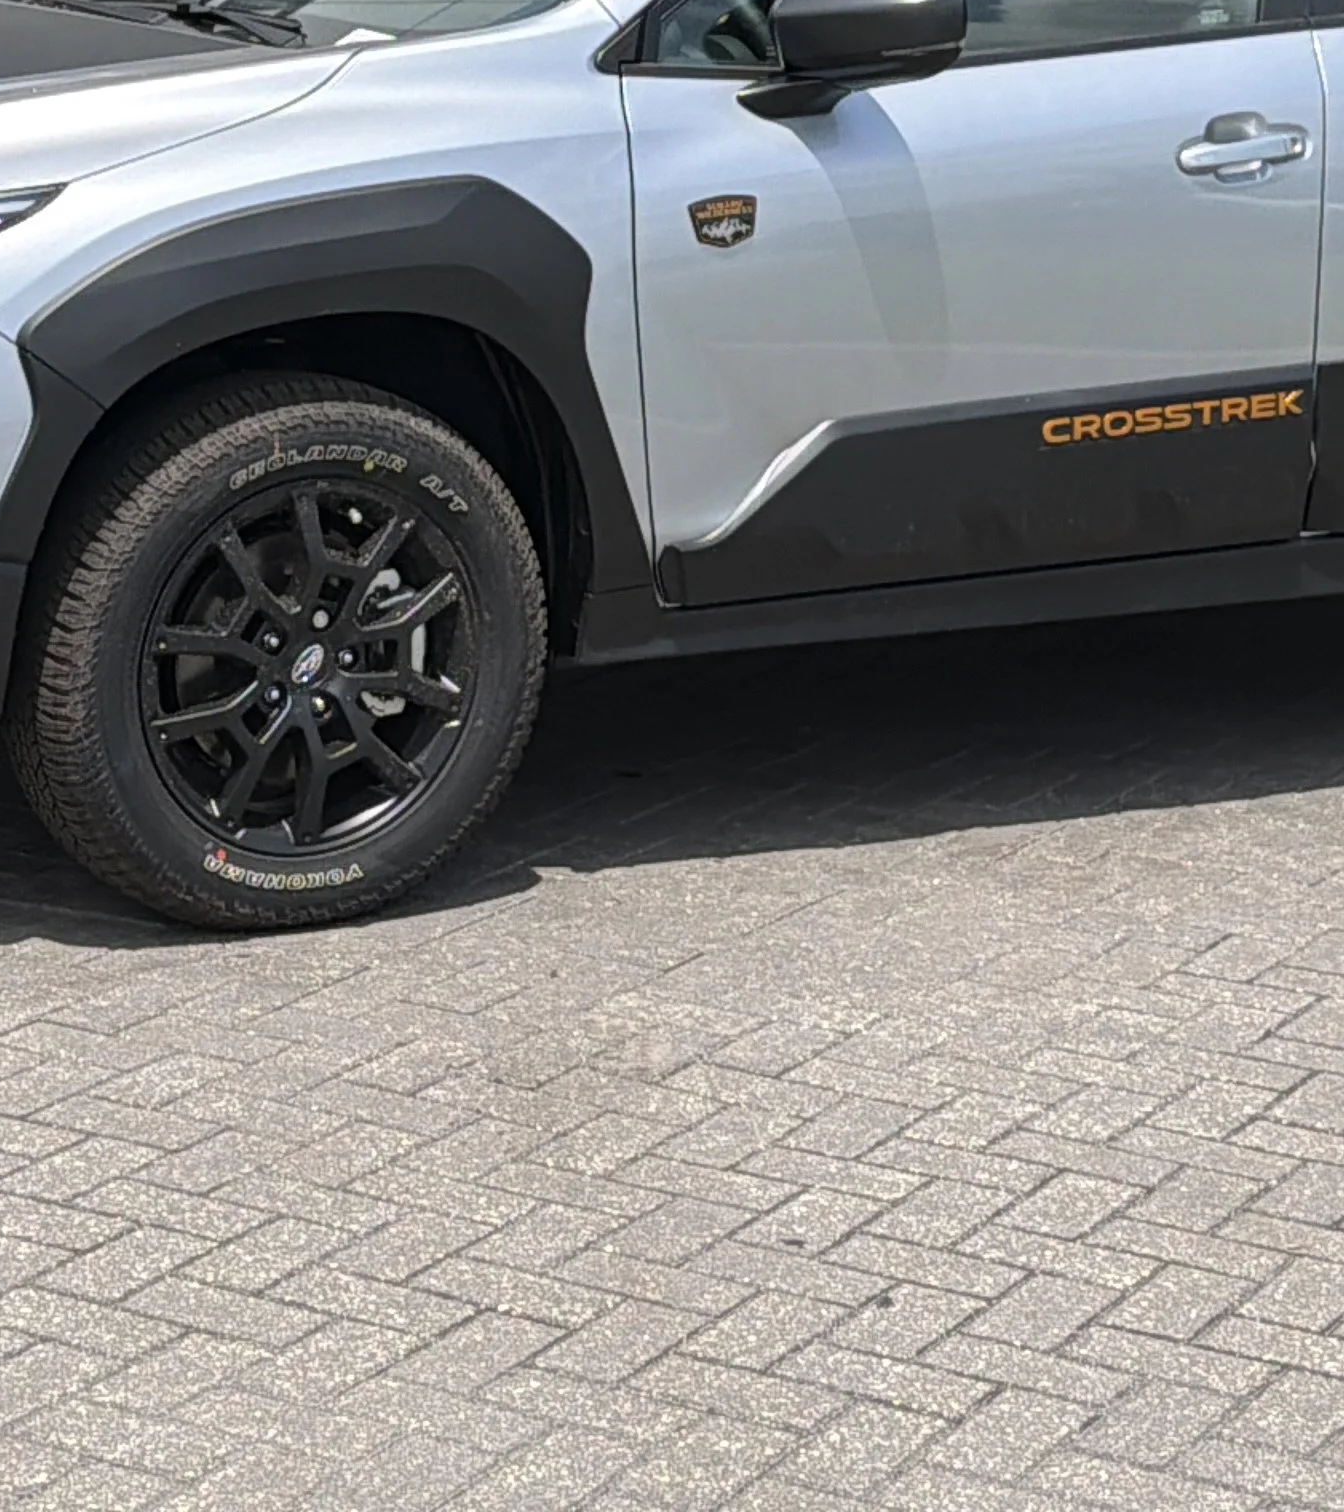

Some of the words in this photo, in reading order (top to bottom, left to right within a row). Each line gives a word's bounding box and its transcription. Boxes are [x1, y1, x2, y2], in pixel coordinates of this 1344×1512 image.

[1041, 388, 1305, 445] CROSSTREK
[230, 444, 408, 490] GEOLANDAR
[419, 473, 469, 513] A/T
[203, 853, 365, 890] YOKOHAMA
